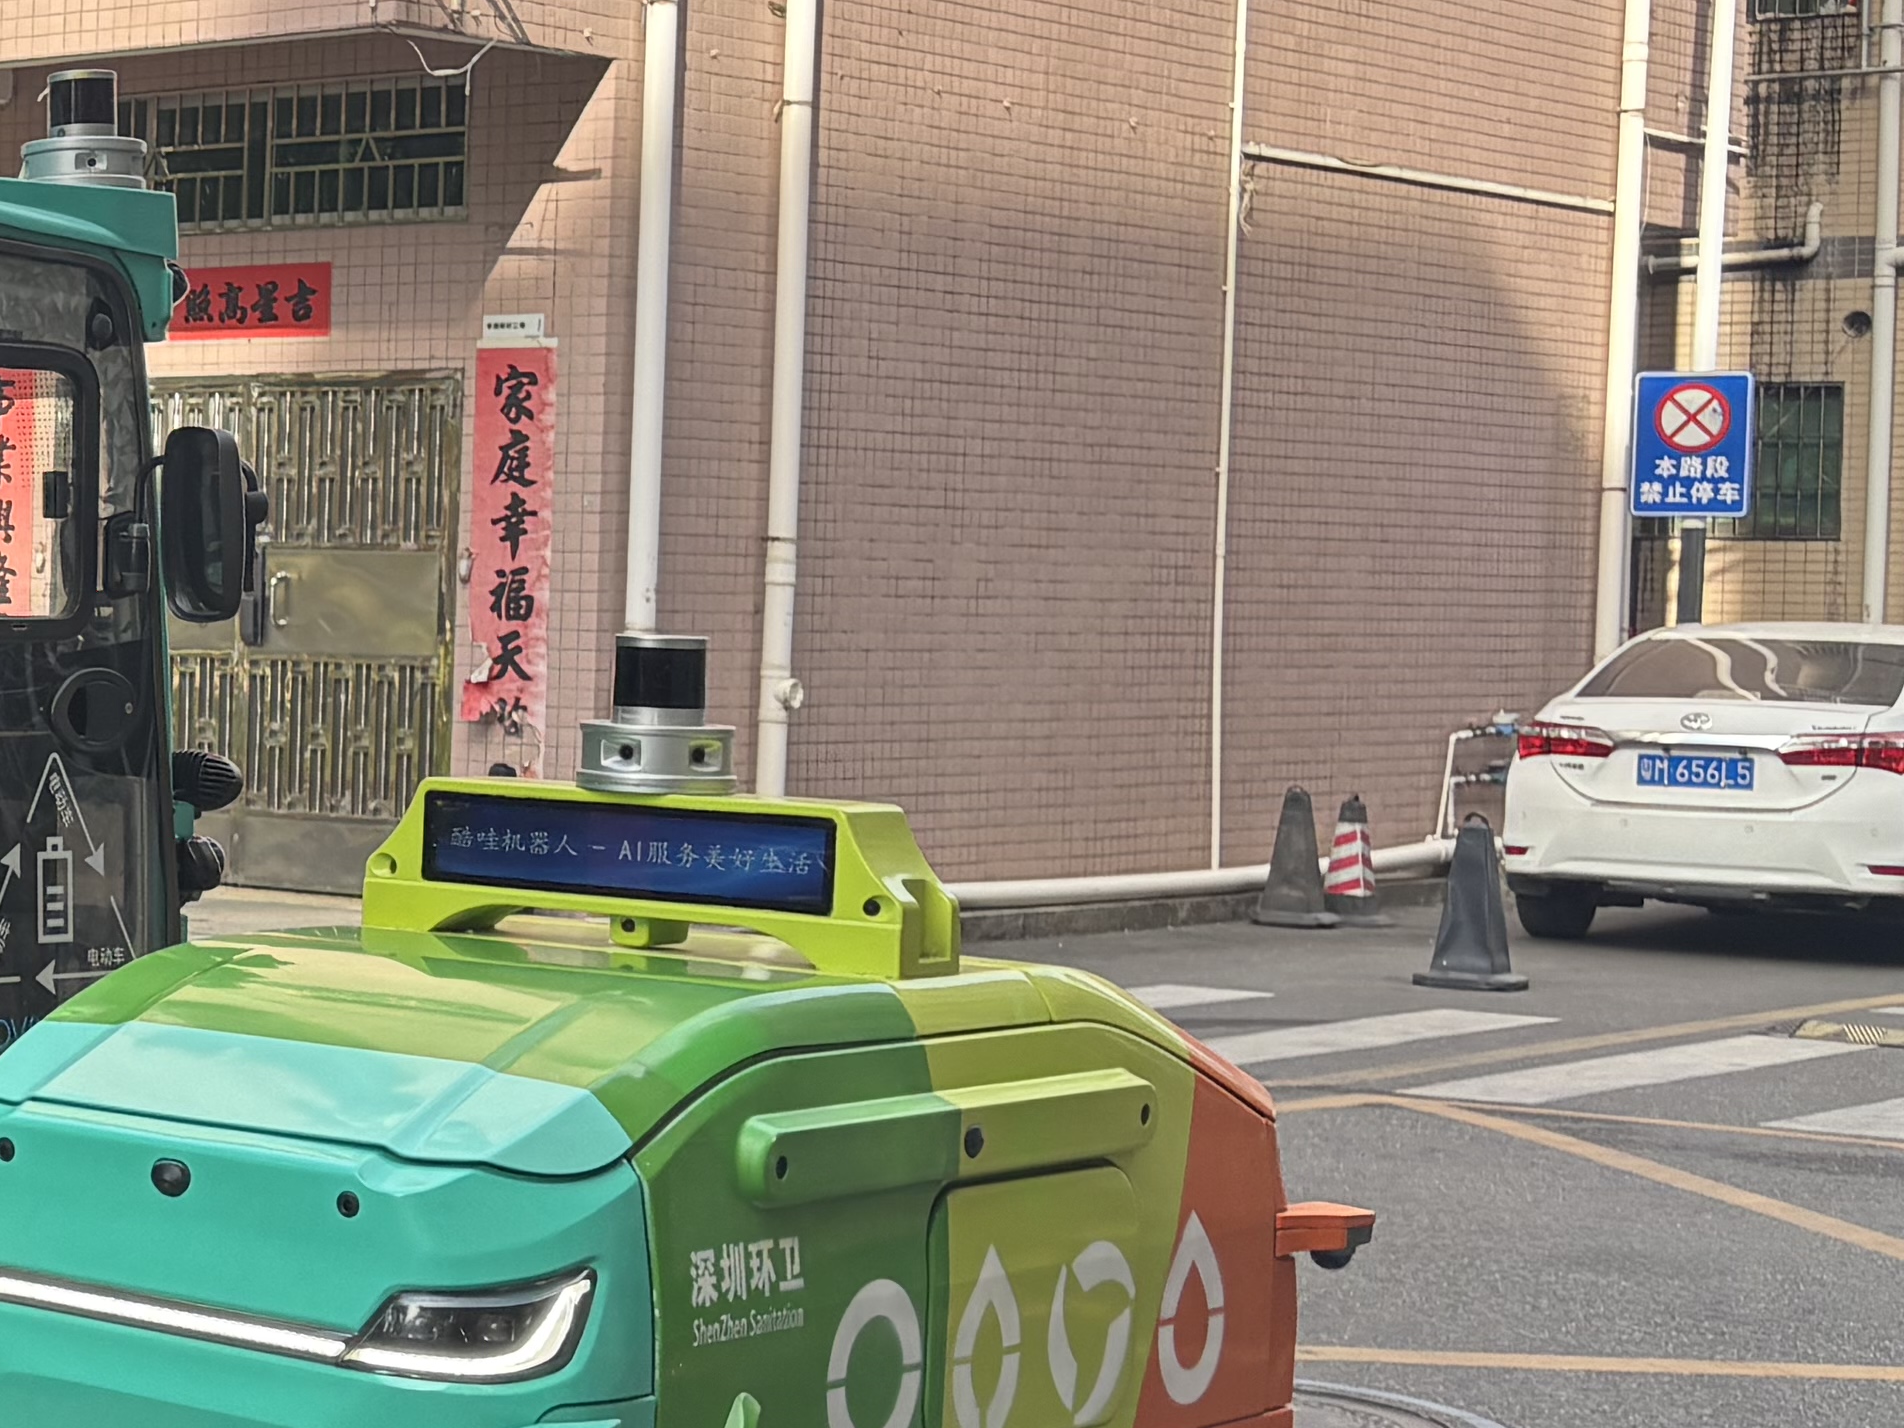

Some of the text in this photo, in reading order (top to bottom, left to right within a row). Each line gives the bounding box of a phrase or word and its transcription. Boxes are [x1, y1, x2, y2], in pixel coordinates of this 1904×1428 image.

[1654, 455, 1730, 479] 本路段
[1639, 481, 1741, 505] 禁止停车
[49, 771, 75, 828] 电动车
[449, 825, 579, 857] 酷哇机器人
[617, 839, 813, 875] AI服务美好生活
[86, 946, 127, 967] 电动车
[690, 1236, 805, 1308] 深圳环卫
[692, 1302, 805, 1347] ShenZhen Sanitation
